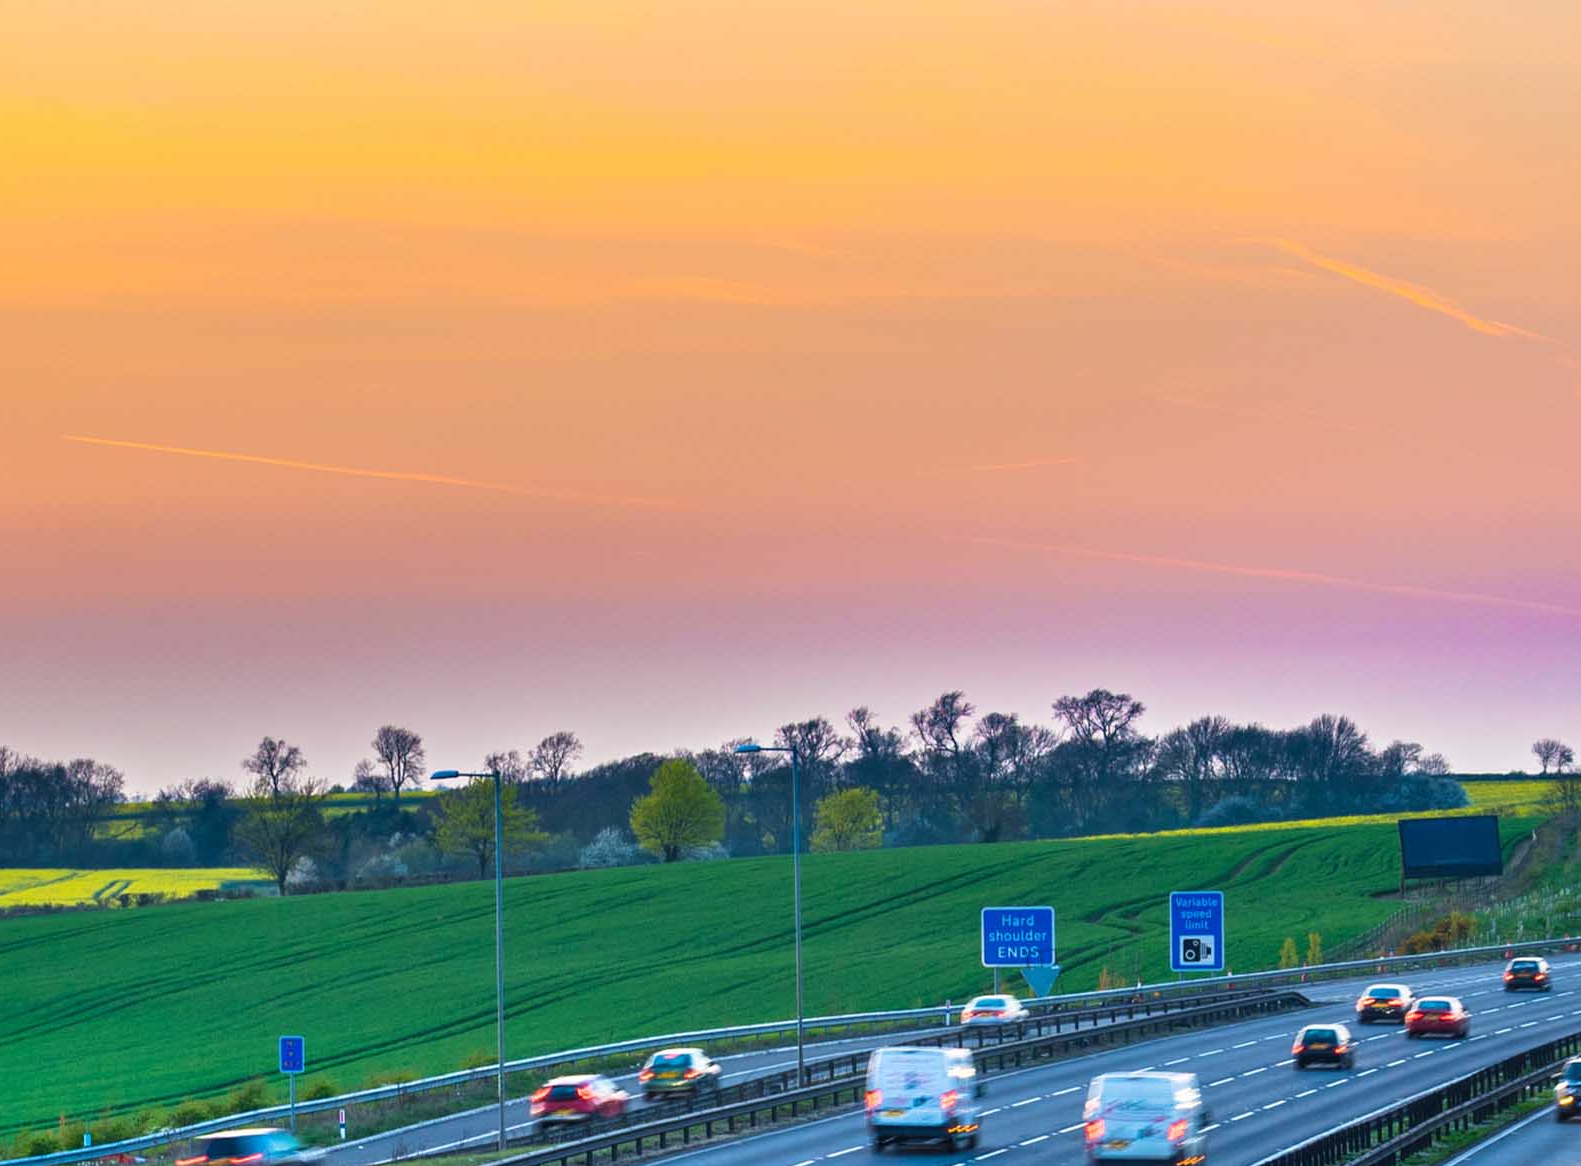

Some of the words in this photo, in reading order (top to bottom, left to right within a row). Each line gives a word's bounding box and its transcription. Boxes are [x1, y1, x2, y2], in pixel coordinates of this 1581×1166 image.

[1176, 896, 1218, 908] Variable
[1002, 914, 1035, 927] Hard
[1180, 909, 1211, 920] speed
[1185, 919, 1209, 929] limit
[988, 929, 1047, 942] shoulder
[998, 946, 1039, 958] ENDS
